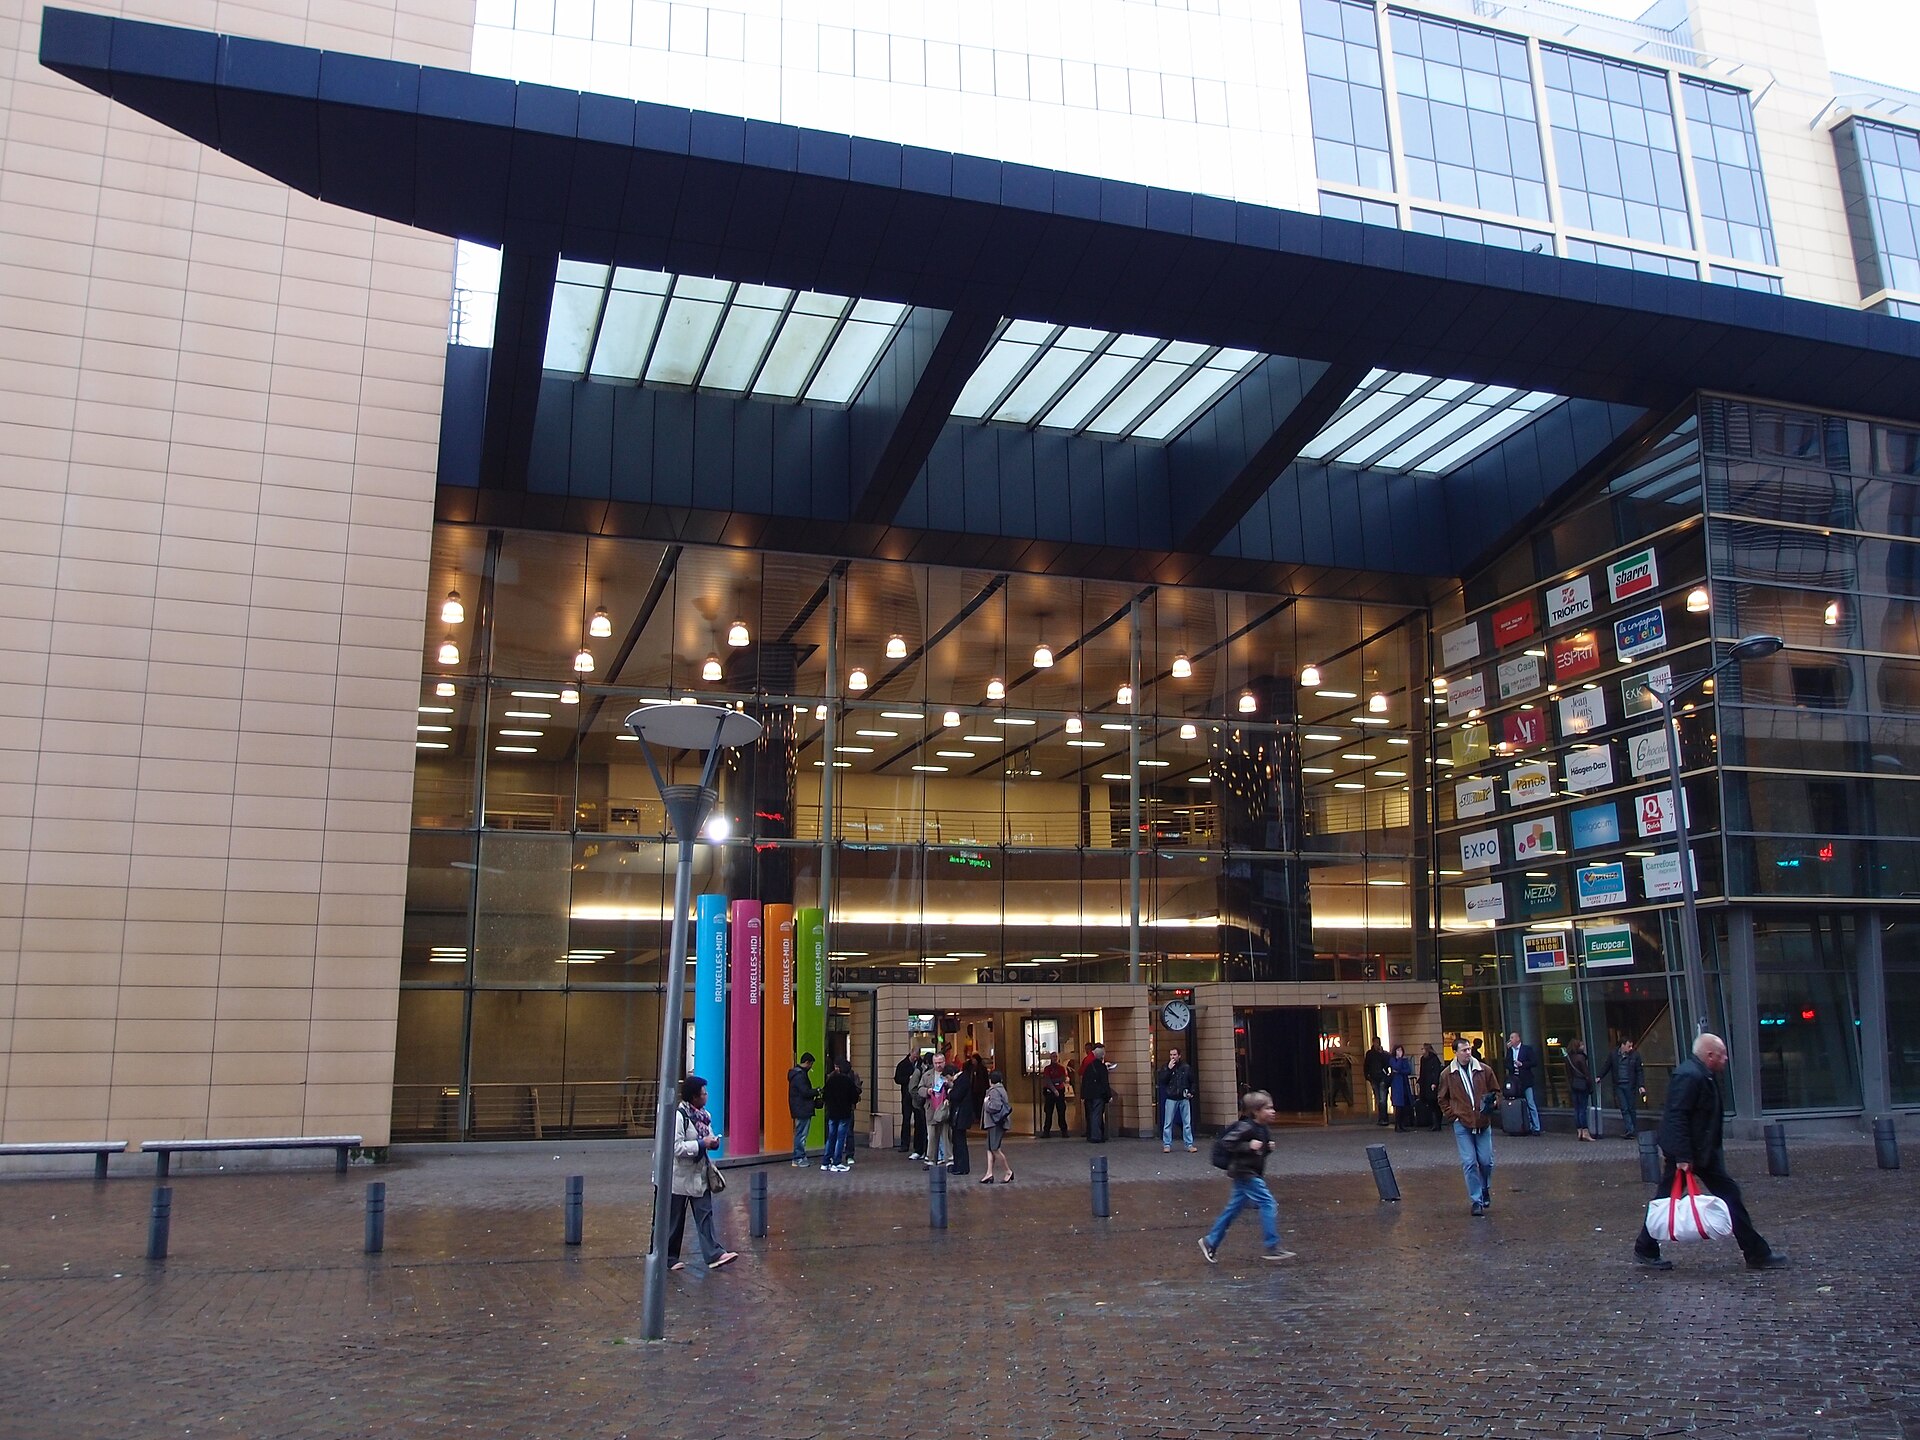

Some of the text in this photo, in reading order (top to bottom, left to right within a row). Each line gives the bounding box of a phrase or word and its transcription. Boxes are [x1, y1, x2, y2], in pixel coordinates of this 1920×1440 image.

[1615, 564, 1649, 587] sbarro
[1551, 599, 1589, 621] TRIOPTIC
[1557, 644, 1594, 669] ESPRIT
[1517, 659, 1537, 673] Cash
[1625, 686, 1644, 700] EXK
[1570, 695, 1588, 709] Jean
[1571, 705, 1593, 719] Louis
[1573, 717, 1594, 732] David
[1515, 774, 1547, 791] Panos
[1459, 786, 1492, 808] SUBWAY
[1646, 821, 1661, 831] Quick
[1463, 840, 1497, 860] EXPO
[1645, 859, 1677, 871] Carrefour
[1524, 883, 1557, 900] MEZZO
[1603, 893, 1618, 903] 7/7
[1537, 897, 1553, 905] PASTA
[1526, 935, 1559, 946] WESTERN
[1535, 943, 1560, 952] UNION
[1591, 939, 1625, 952] Europcar
[715, 931, 723, 1003] BRUXELLES-MIDI
[750, 935, 758, 1005] BRUXELLES-MIDI
